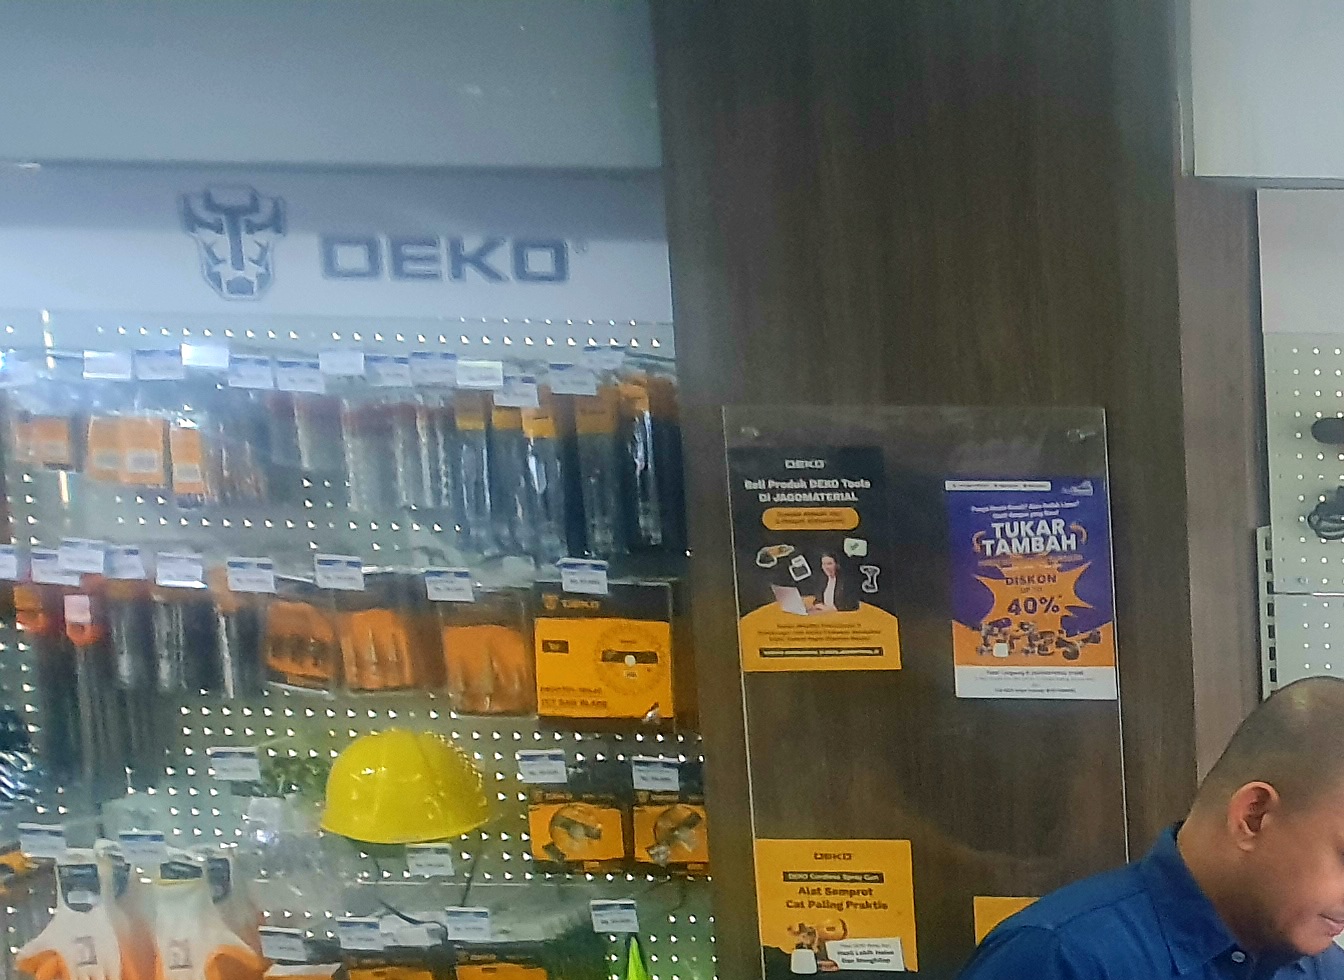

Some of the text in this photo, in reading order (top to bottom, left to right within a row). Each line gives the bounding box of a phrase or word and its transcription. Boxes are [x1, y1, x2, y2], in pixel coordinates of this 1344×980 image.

[773, 492, 859, 502] JAGOMATERIAL
[990, 517, 1067, 540] TUKAR
[982, 532, 1078, 557] TAMBAH
[1005, 574, 1058, 586] DISKON
[798, 887, 874, 898] Alat Semprot
[808, 900, 844, 911] Paling
[846, 901, 889, 910] Praktis
